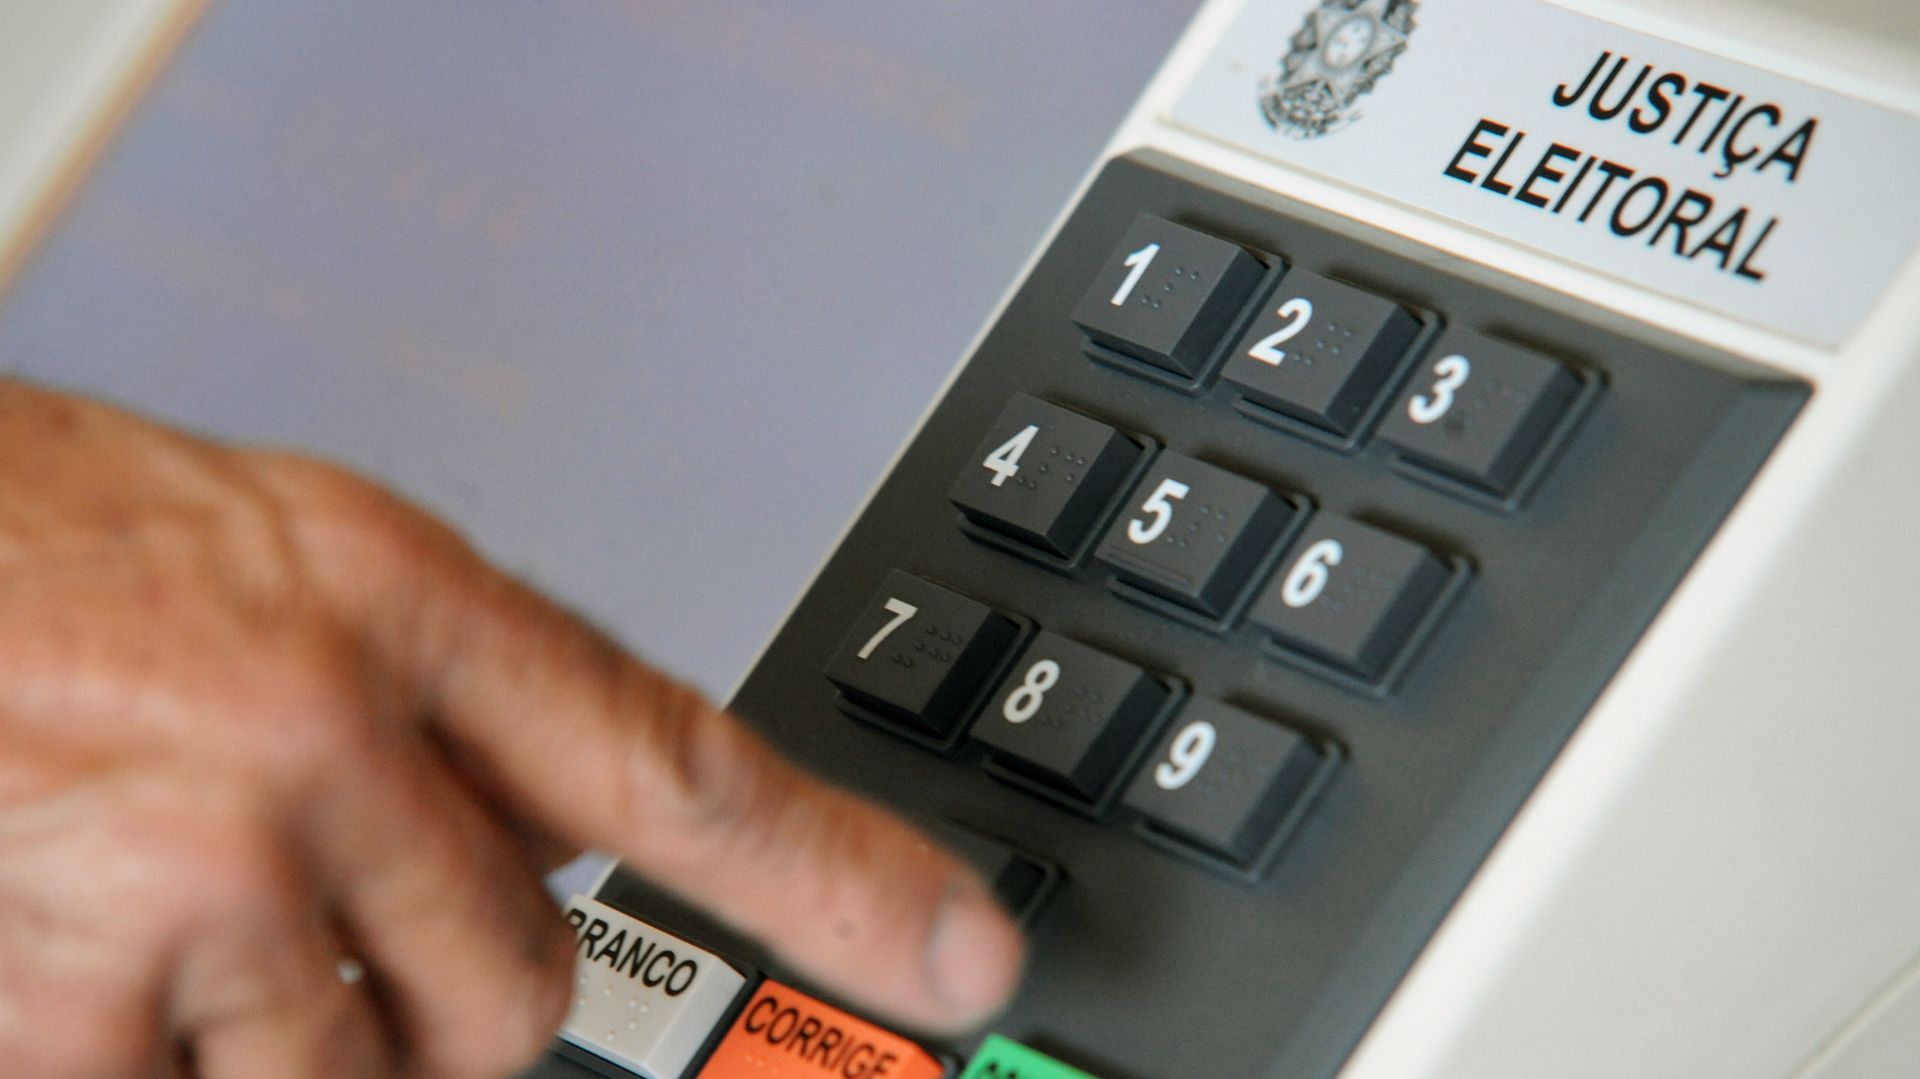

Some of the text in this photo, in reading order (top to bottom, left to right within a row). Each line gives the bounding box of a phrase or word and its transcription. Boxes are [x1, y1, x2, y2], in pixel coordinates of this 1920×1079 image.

[1552, 51, 1819, 182] JUSTIÇA
[1443, 118, 1779, 281] ELEITORAL
[1110, 243, 1160, 306] 1
[1248, 298, 1313, 366] 2
[1408, 355, 1470, 424] 3
[983, 424, 1039, 487] 4
[1128, 478, 1189, 544] 5
[1281, 539, 1343, 608] 6
[858, 597, 918, 660] 7
[1003, 659, 1060, 723] 8
[1155, 721, 1216, 790] 9
[744, 996, 898, 1079] CORRIGE
